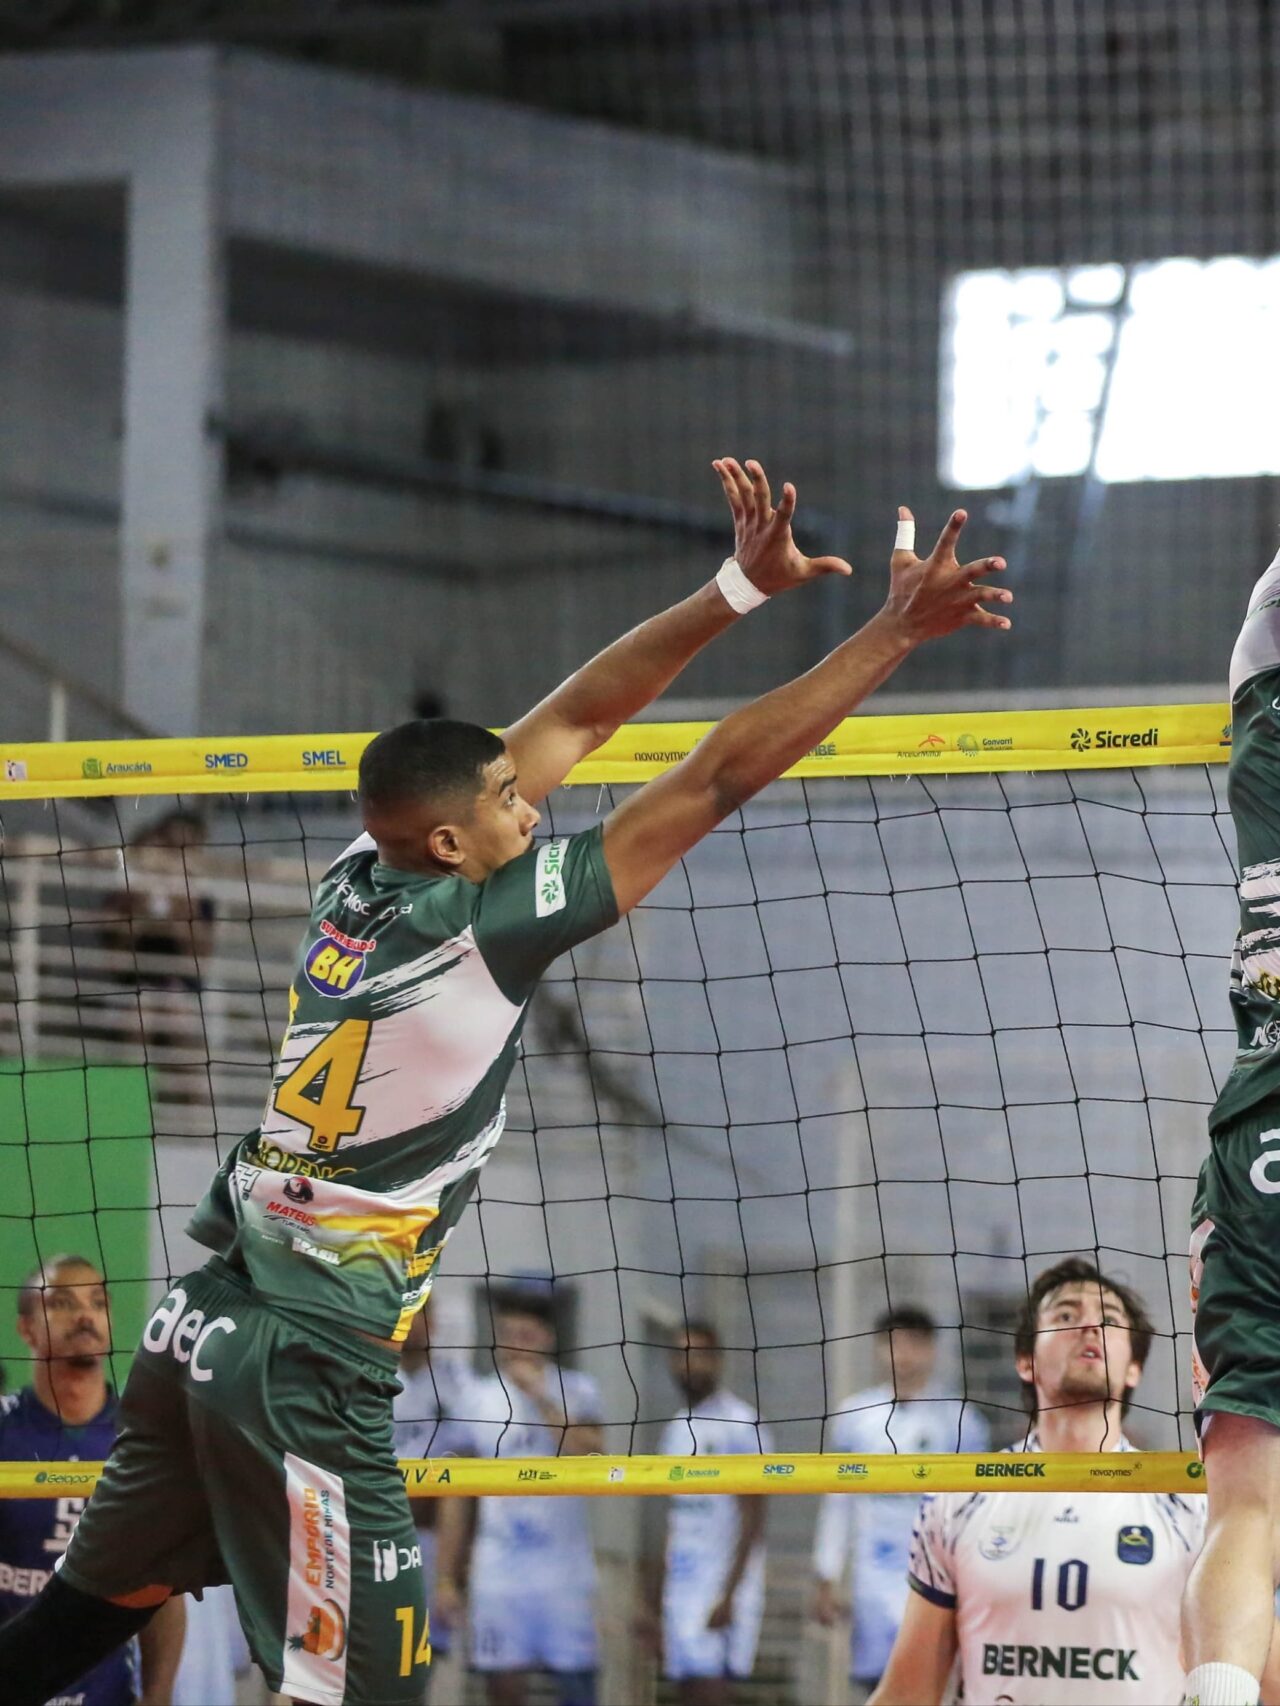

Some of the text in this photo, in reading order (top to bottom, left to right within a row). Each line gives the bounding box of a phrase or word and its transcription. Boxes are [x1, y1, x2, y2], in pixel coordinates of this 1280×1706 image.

[1096, 728, 1158, 749] Sicredi
[205, 753, 249, 769] SMED
[302, 750, 346, 766] SMEL
[309, 947, 362, 989] BH
[273, 1018, 374, 1154] 4
[266, 1201, 317, 1227] MATEUS
[763, 1464, 795, 1475] SMED
[838, 1464, 869, 1474] SMEL
[975, 1463, 1045, 1477] BERNECK
[1089, 1467, 1132, 1478] novozymes
[321, 1489, 332, 1528] MINAS
[304, 1487, 321, 1587] EMPÓRIO
[325, 1547, 334, 1589] NORTE
[1031, 1557, 1089, 1612] 10
[395, 1606, 433, 1677] 14
[982, 1643, 1140, 1681] BERNECK
